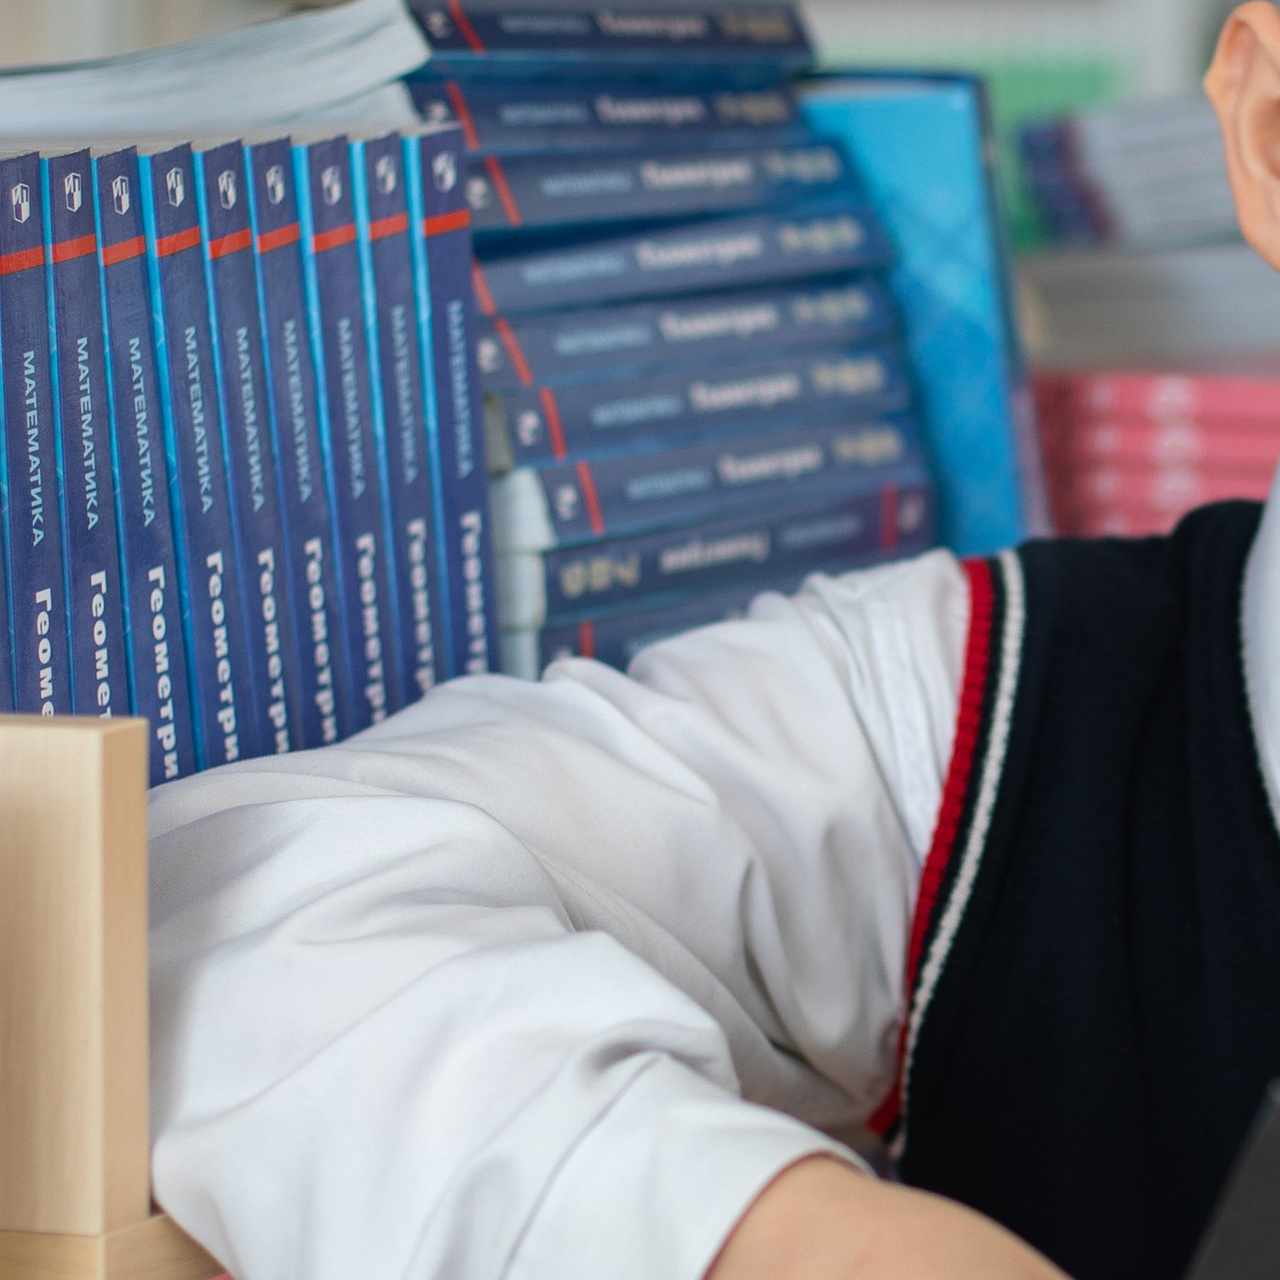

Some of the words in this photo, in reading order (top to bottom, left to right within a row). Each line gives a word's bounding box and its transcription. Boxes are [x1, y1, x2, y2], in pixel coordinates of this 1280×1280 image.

[23, 350, 46, 548] МАТЕМАТИКА
[77, 337, 100, 531] МАТЕМАТИКА
[185, 326, 213, 515] МАТЕМАТИКА
[236, 326, 265, 514] МАТЕМАТИКА
[129, 337, 155, 528] МАТЕМАТИКА
[148, 565, 179, 780] Геометри
